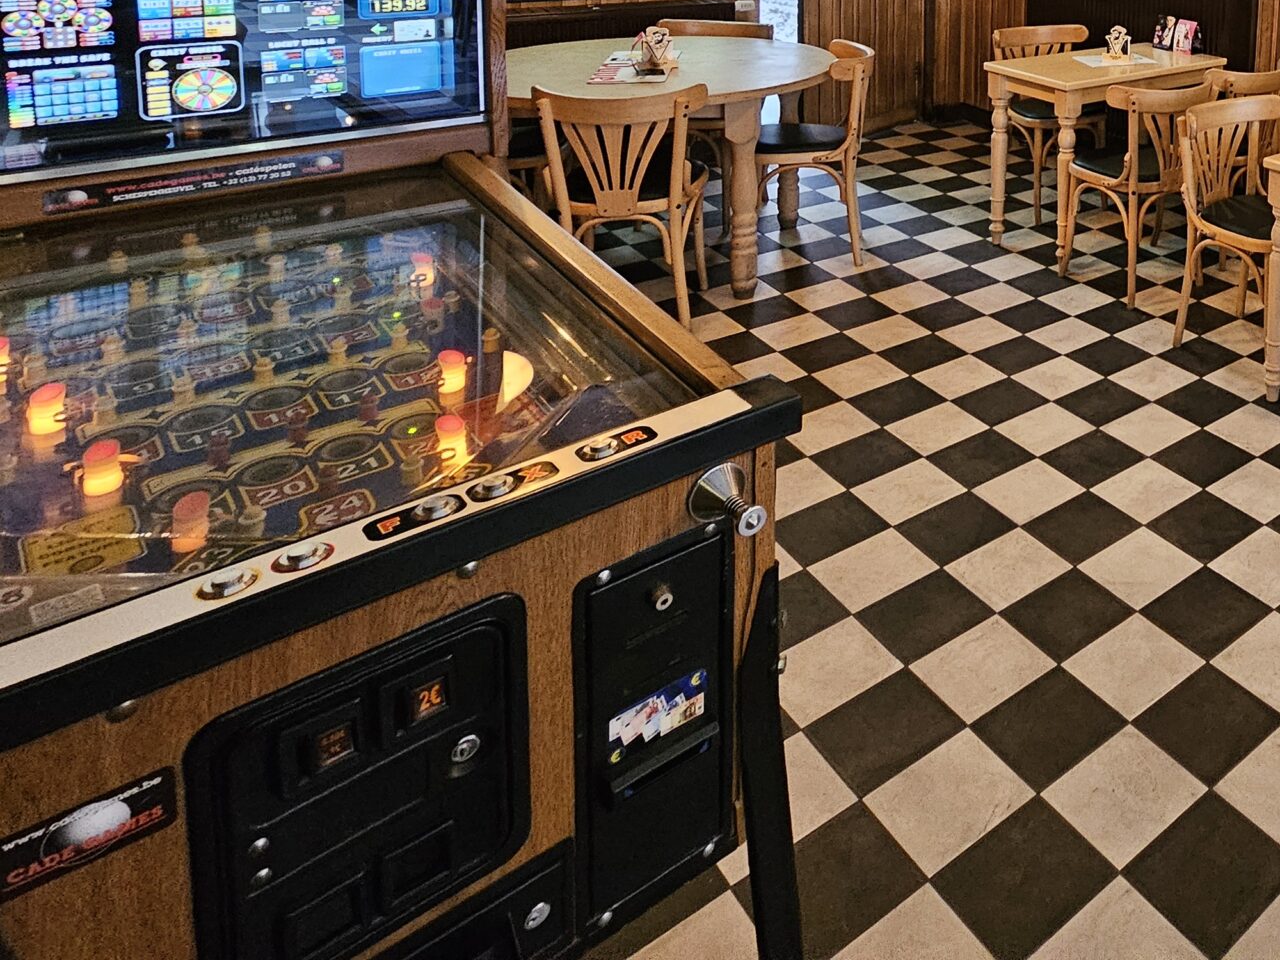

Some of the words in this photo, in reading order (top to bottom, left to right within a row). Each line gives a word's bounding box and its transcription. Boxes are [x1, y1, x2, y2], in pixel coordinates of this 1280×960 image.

[53, 55, 79, 64] THE
[235, 161, 296, 178] caféspelen
[620, 428, 648, 446] R
[337, 456, 379, 479] 21
[518, 464, 549, 485] X
[256, 480, 307, 506] 20
[376, 516, 401, 535] F
[419, 683, 442, 712] 2€
[6, 845, 77, 884] CADE
[82, 805, 164, 851] GAMES
